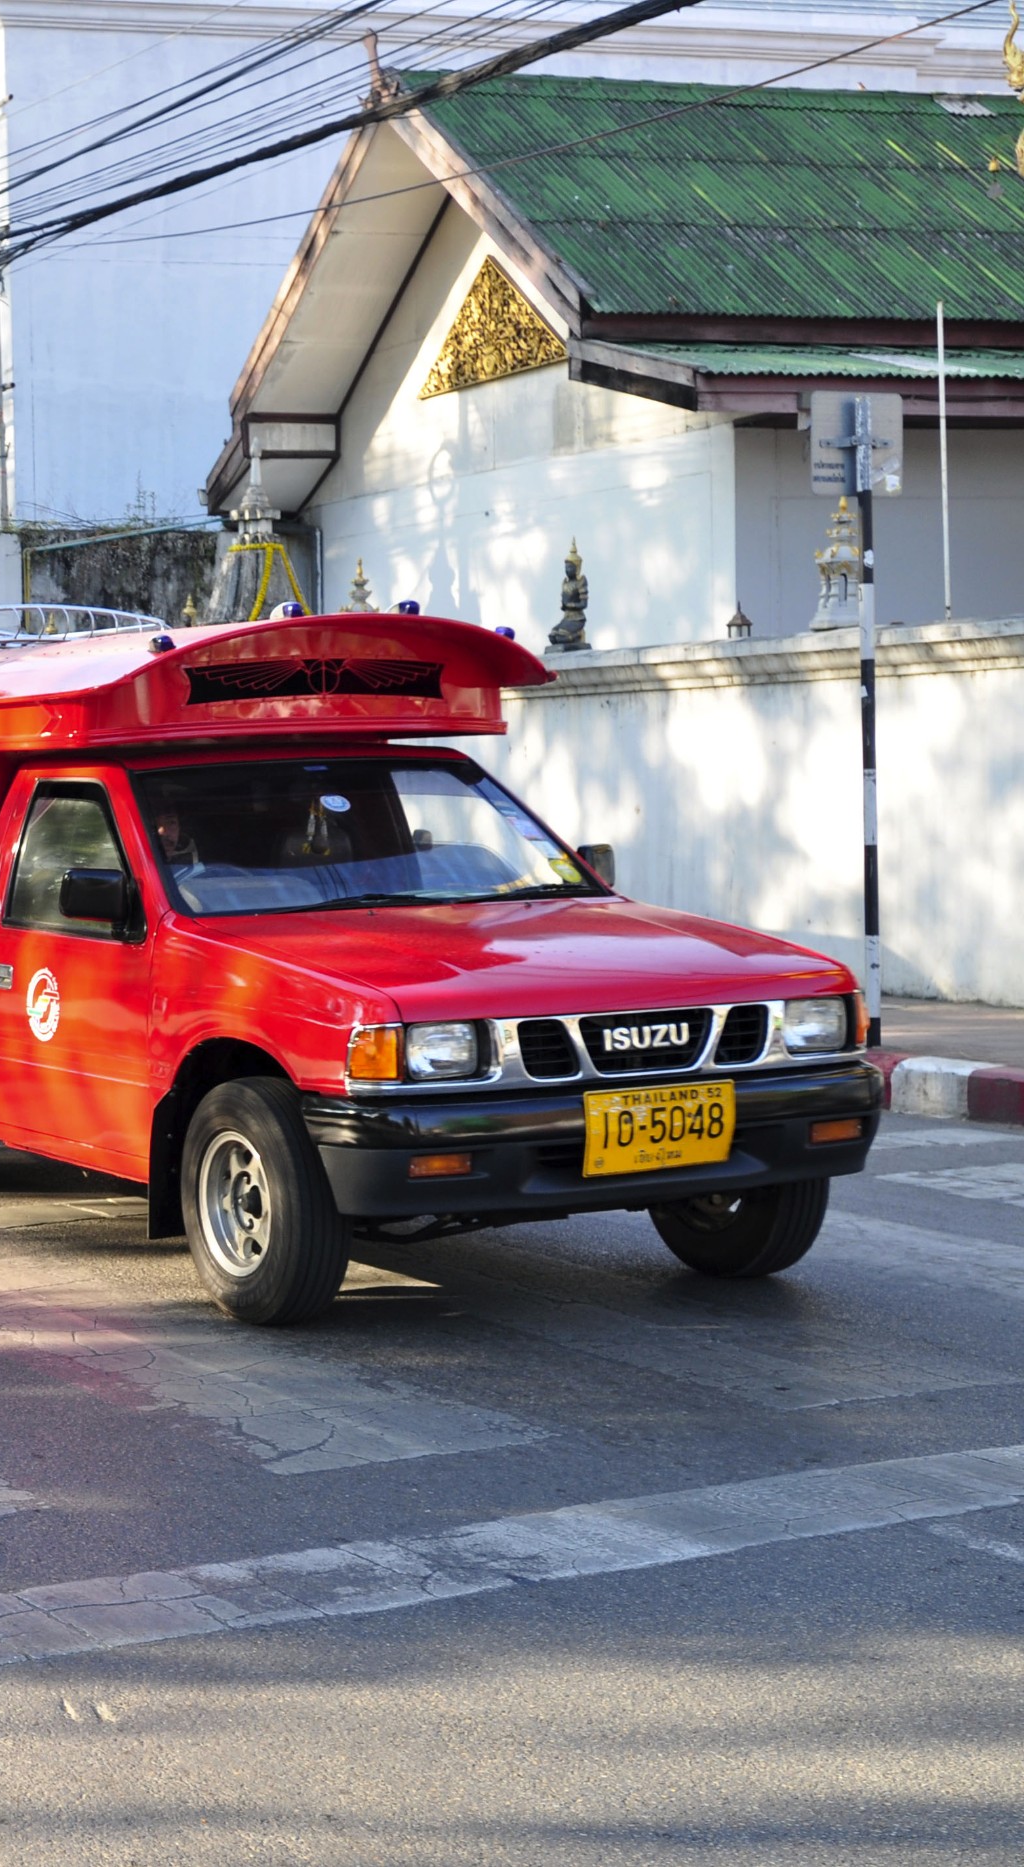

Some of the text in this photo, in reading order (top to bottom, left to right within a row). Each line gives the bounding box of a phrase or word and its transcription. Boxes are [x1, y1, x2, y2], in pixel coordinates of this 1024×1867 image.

[602, 1022, 690, 1052] ISUZU
[622, 1087, 722, 1106] THAILAND 52
[602, 1102, 724, 1149] 10-5048
